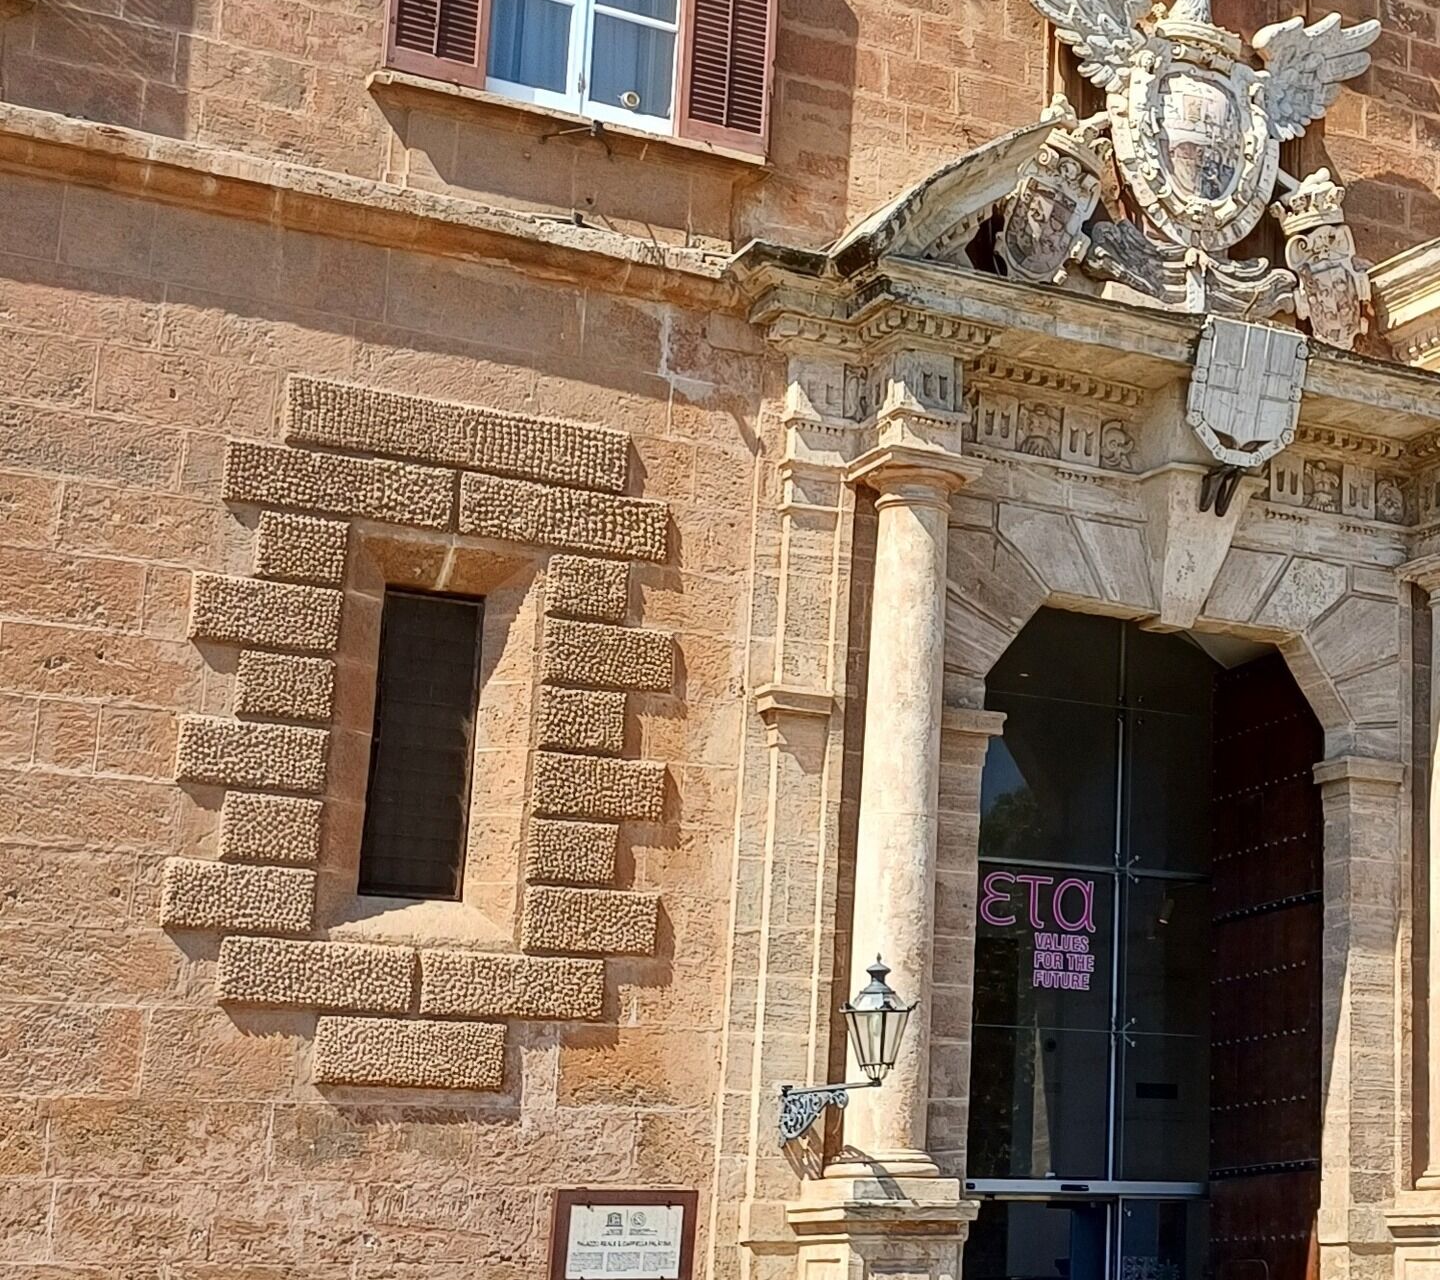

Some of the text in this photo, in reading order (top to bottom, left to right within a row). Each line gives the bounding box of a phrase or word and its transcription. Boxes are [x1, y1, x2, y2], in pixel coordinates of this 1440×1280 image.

[1034, 931, 1090, 953] VALUES
[1033, 950, 1095, 972] FOR THE
[1033, 969, 1091, 991] FUTURE
